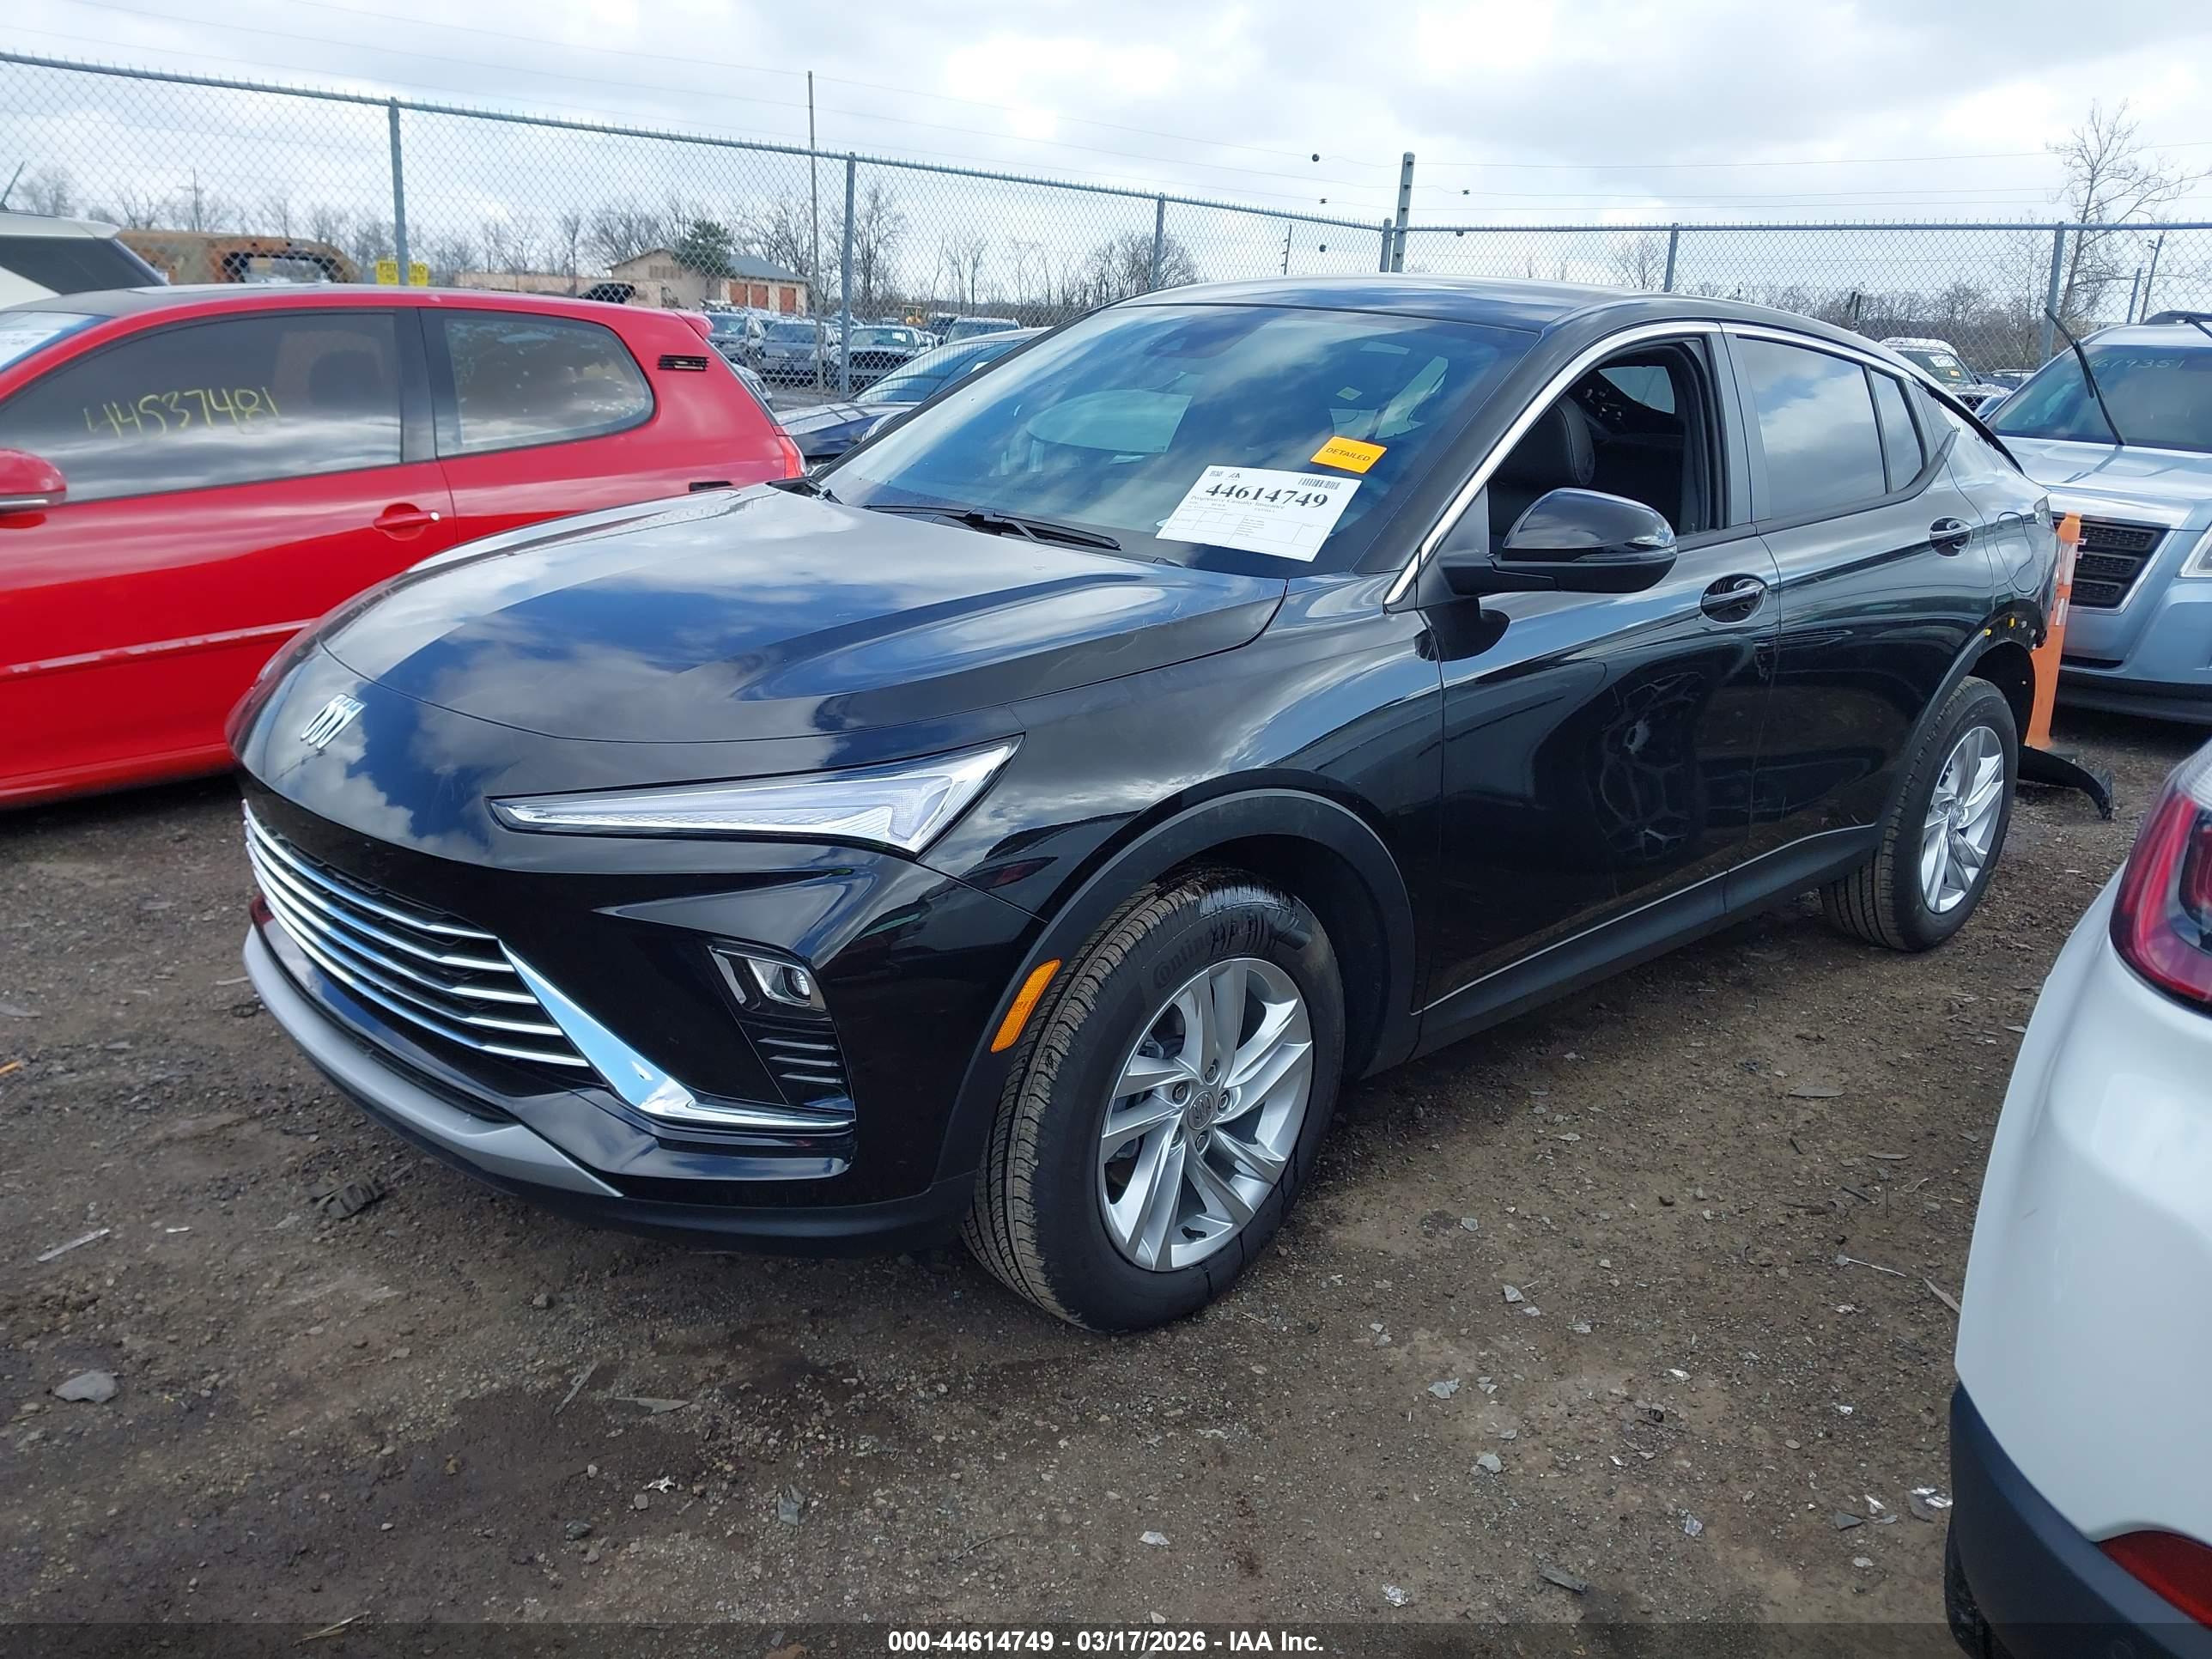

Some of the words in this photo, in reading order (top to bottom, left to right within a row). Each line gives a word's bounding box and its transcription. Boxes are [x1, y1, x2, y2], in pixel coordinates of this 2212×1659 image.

[83, 386, 280, 441] 44537481
[1325, 447, 1370, 461] DETAILED
[1205, 483, 1328, 507] 44614749
